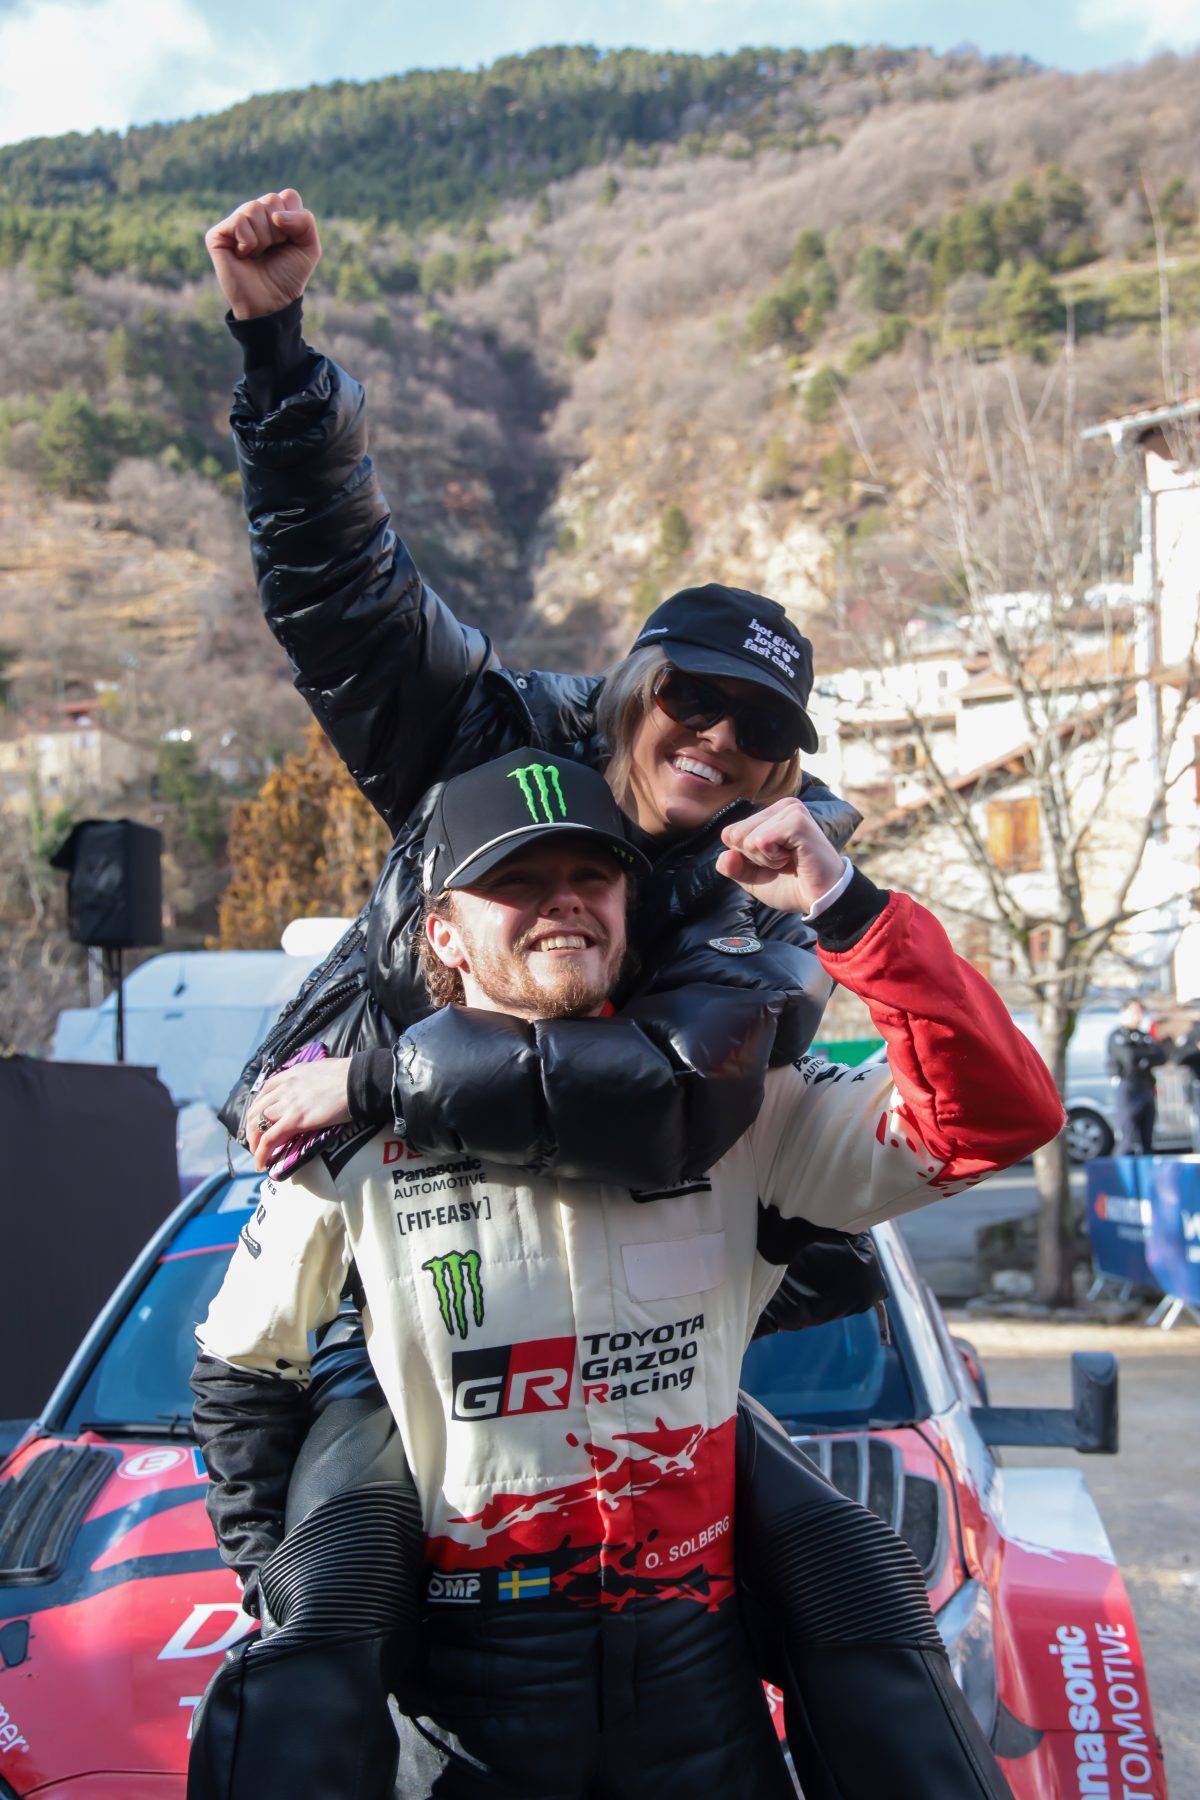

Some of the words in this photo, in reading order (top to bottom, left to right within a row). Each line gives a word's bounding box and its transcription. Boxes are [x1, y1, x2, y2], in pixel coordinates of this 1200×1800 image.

[742, 638, 772, 659] fast
[771, 654, 796, 679] cars
[748, 618, 774, 638] hot
[772, 635, 801, 659] girls
[753, 632, 782, 655] love
[391, 1155, 482, 1185] Panasonic
[393, 1172, 488, 1200] AUTOMOTIVE
[581, 1312, 705, 1356] TOYOTA
[581, 1339, 699, 1381] GAZOO
[454, 1366, 570, 1419] GR
[582, 1365, 696, 1406] Racing
[644, 1549, 665, 1570] O.
[668, 1514, 731, 1562] SOLBERG
[427, 1580, 481, 1600] OMP
